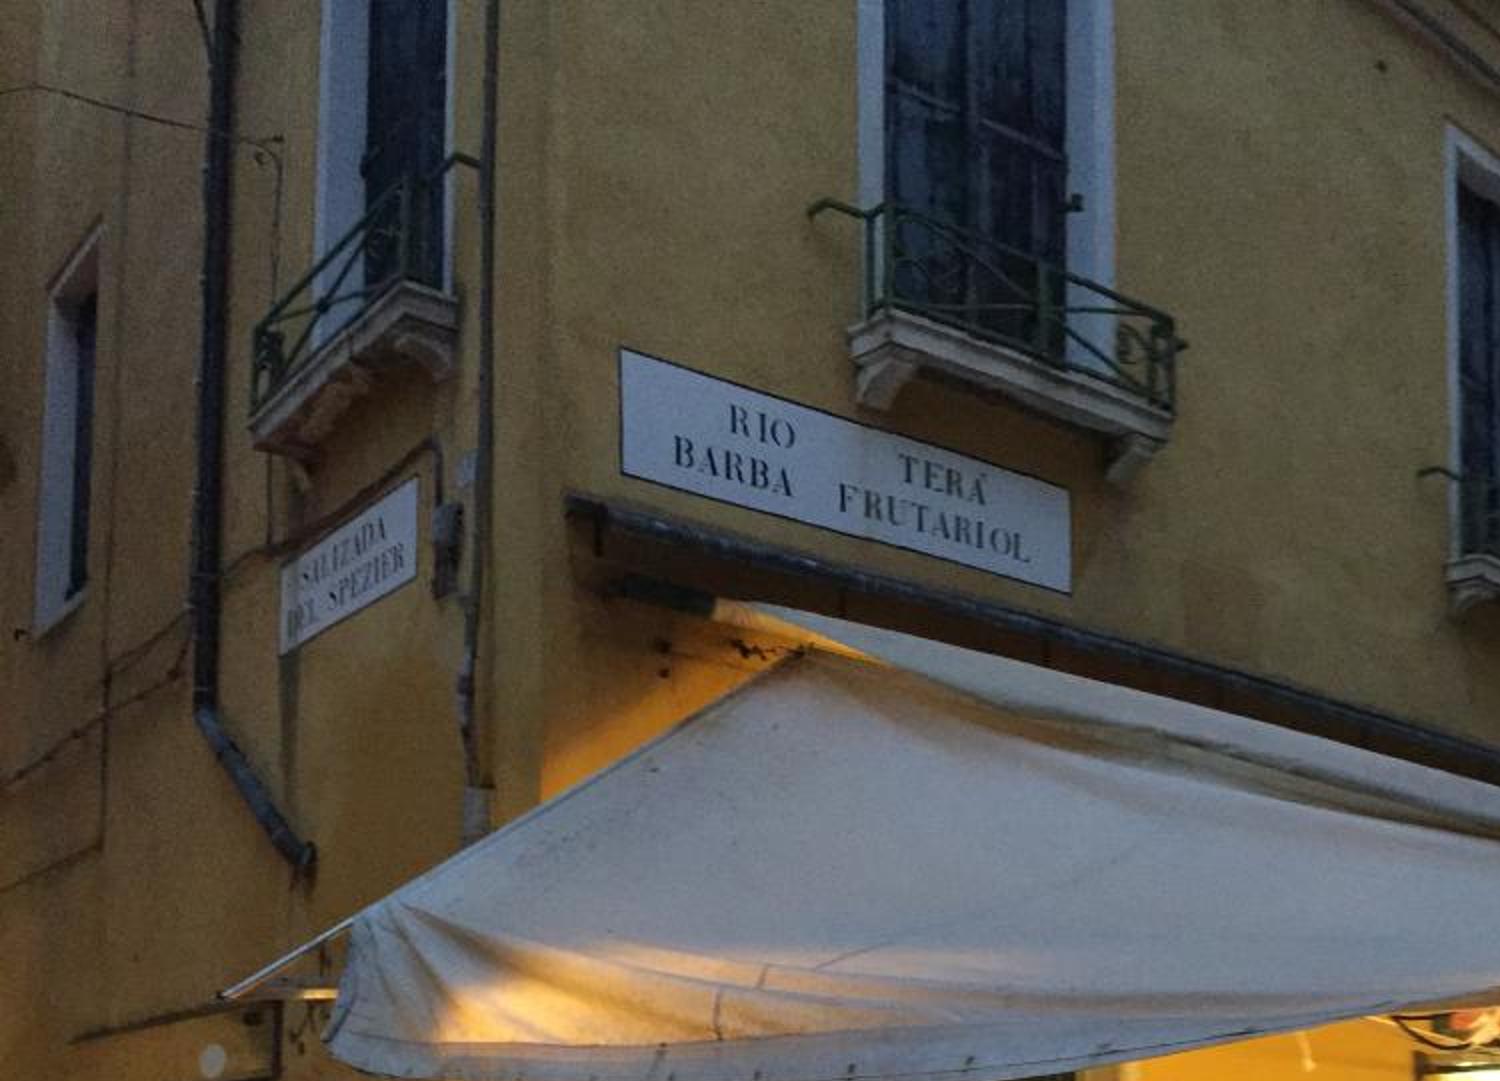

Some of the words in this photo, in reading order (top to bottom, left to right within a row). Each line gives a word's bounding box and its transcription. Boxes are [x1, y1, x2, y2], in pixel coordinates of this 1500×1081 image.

[729, 402, 797, 450] RIO
[673, 434, 796, 498] BARBA
[838, 483, 1031, 563] FRUTARIOL
